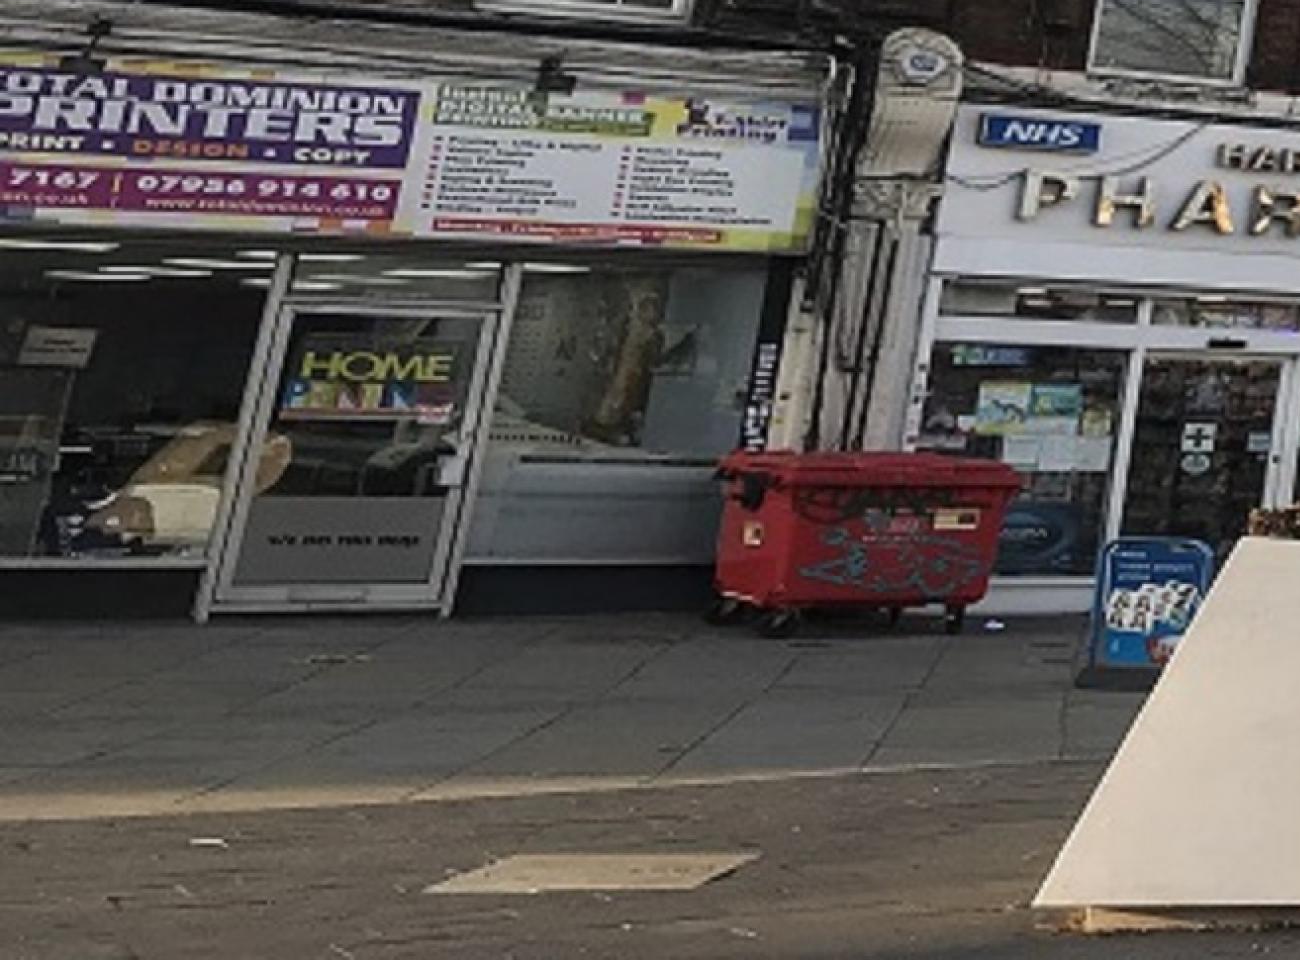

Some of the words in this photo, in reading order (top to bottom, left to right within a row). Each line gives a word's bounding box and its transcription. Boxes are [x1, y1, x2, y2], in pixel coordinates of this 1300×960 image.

[0, 71, 128, 98] OTAL
[153, 79, 402, 115] DOMINION
[0, 94, 401, 146] PRINTERS
[676, 124, 777, 144] Printing
[1002, 121, 1083, 146] NHS
[132, 140, 249, 158] DESIGN
[293, 147, 371, 164] COPY
[9, 169, 99, 190] 7167
[257, 179, 321, 198] 914
[330, 182, 391, 201] 610
[302, 352, 453, 381] HOME
